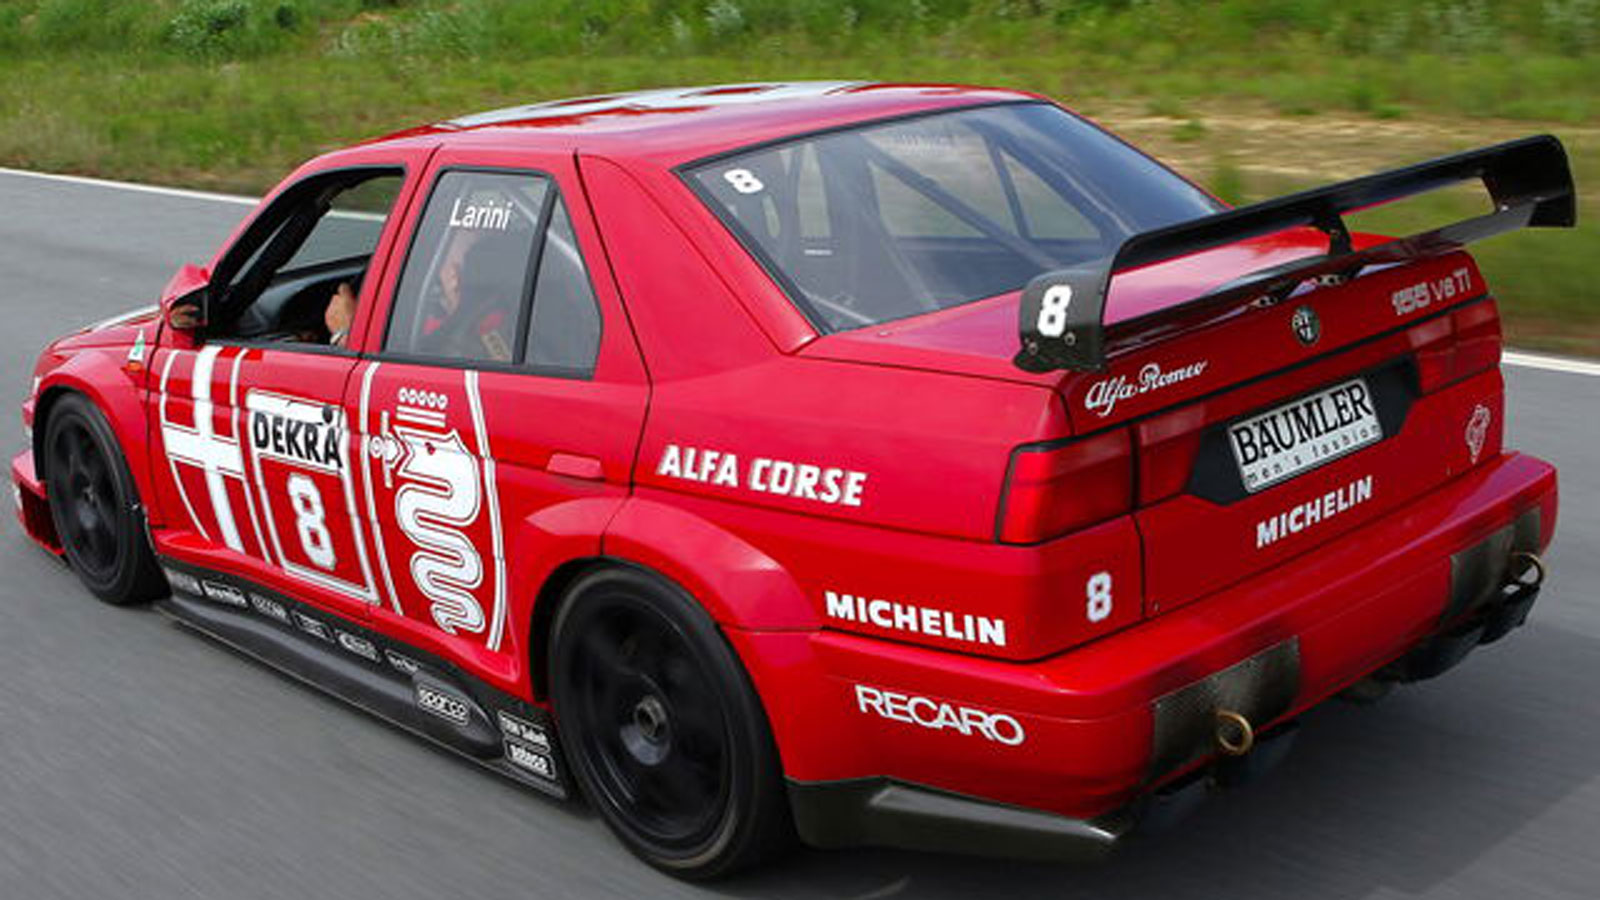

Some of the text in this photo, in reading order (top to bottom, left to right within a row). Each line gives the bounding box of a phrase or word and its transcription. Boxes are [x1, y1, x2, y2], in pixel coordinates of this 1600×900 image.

[724, 169, 764, 193] 8
[450, 198, 513, 231] Larini
[1037, 285, 1072, 337] 8
[1085, 362, 1208, 418] Alfa Romeo
[253, 411, 343, 469] DEKRA
[1233, 383, 1373, 465] BÄUMLER
[1312, 423, 1379, 458] fashion
[656, 444, 868, 507] ALFA CORSE
[287, 472, 336, 571] 8
[1256, 475, 1373, 549] MICHELIN
[825, 590, 1006, 646] MICHELIN
[1085, 570, 1112, 623] 8
[855, 684, 1025, 746] RECARO
